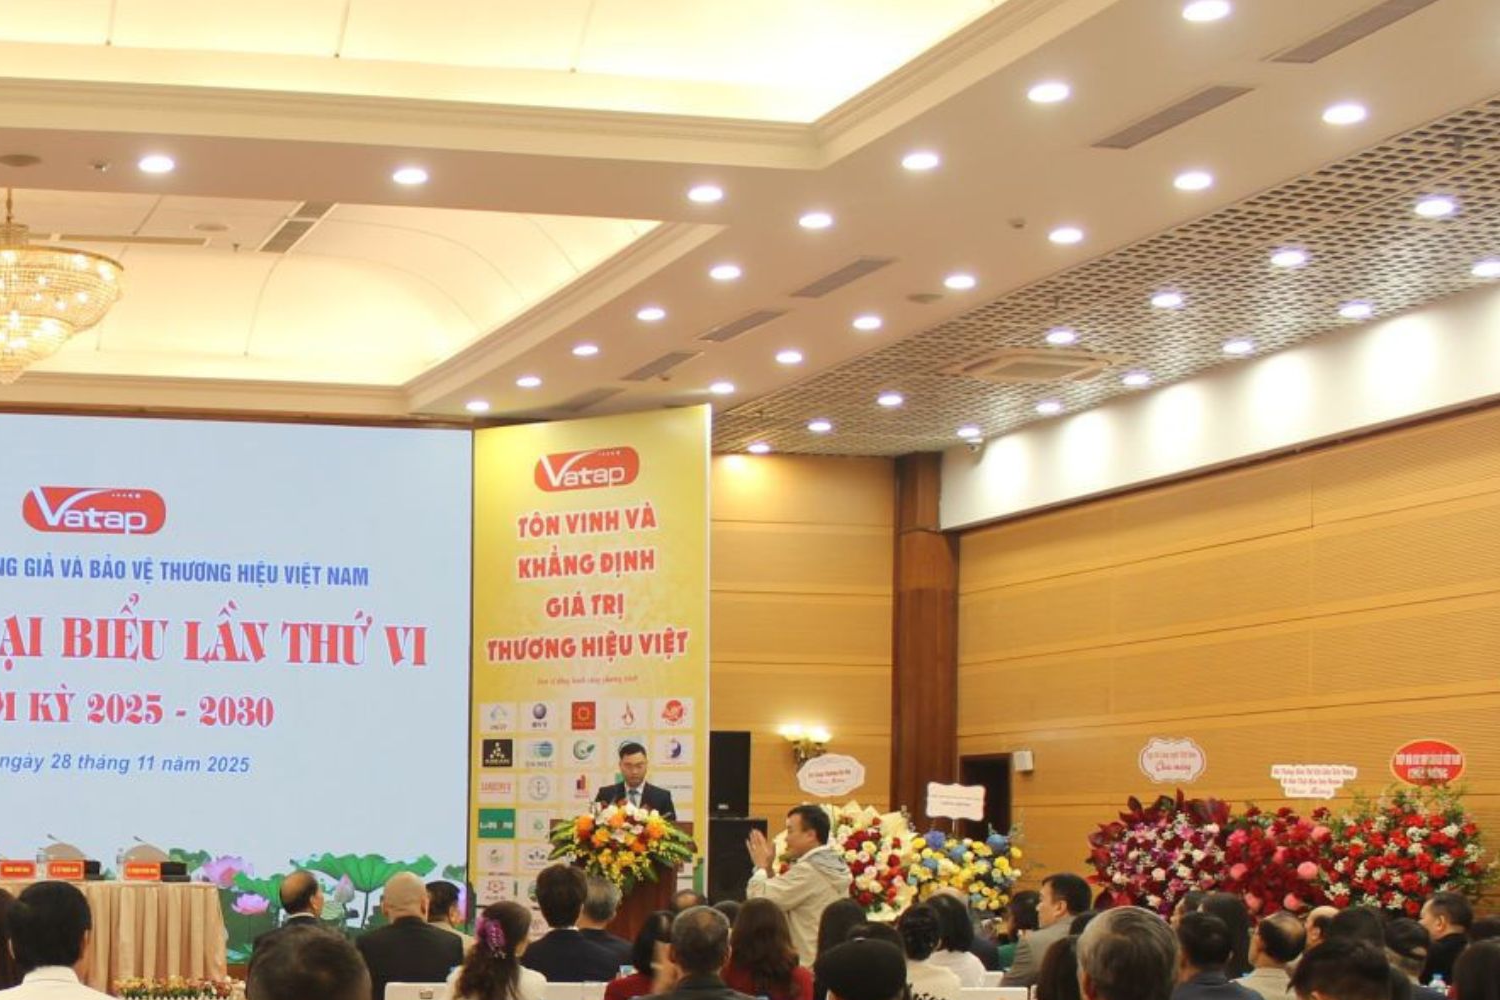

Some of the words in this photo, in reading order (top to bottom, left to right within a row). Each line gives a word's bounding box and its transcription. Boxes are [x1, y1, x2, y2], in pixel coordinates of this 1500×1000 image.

[540, 452, 625, 488] Vatap
[31, 486, 148, 534] Vatap
[518, 512, 559, 538] TÔN
[566, 510, 619, 534] VINH
[625, 502, 656, 529] VÀ
[24, 552, 55, 578] GIẢ
[61, 555, 84, 579] VÀ
[90, 554, 126, 580] BẢO
[132, 556, 154, 584] VỆ
[160, 560, 232, 583] THƯƠNG
[237, 560, 279, 588] HIỆU
[284, 562, 322, 588] VIỆT
[327, 567, 369, 587] NAM
[600, 549, 654, 578] ĐỊNH
[546, 591, 586, 618] GIÁ
[591, 593, 623, 619] TRỊ
[61, 592, 169, 662] BIỂU
[184, 600, 270, 665] LẦN
[281, 608, 374, 666] THỨ
[384, 625, 428, 667] VI
[488, 636, 577, 662] THƯƠNG
[582, 631, 633, 662] HIỆU
[639, 628, 688, 659] VIỆT
[29, 683, 77, 723] KỲ
[87, 693, 164, 725] 2025
[199, 695, 275, 728] 2030
[0, 753, 44, 772] ngày
[51, 753, 73, 770] 28
[77, 753, 131, 774] tháng
[137, 755, 156, 771] 11
[162, 756, 201, 772] năm
[206, 756, 252, 774] 2025
